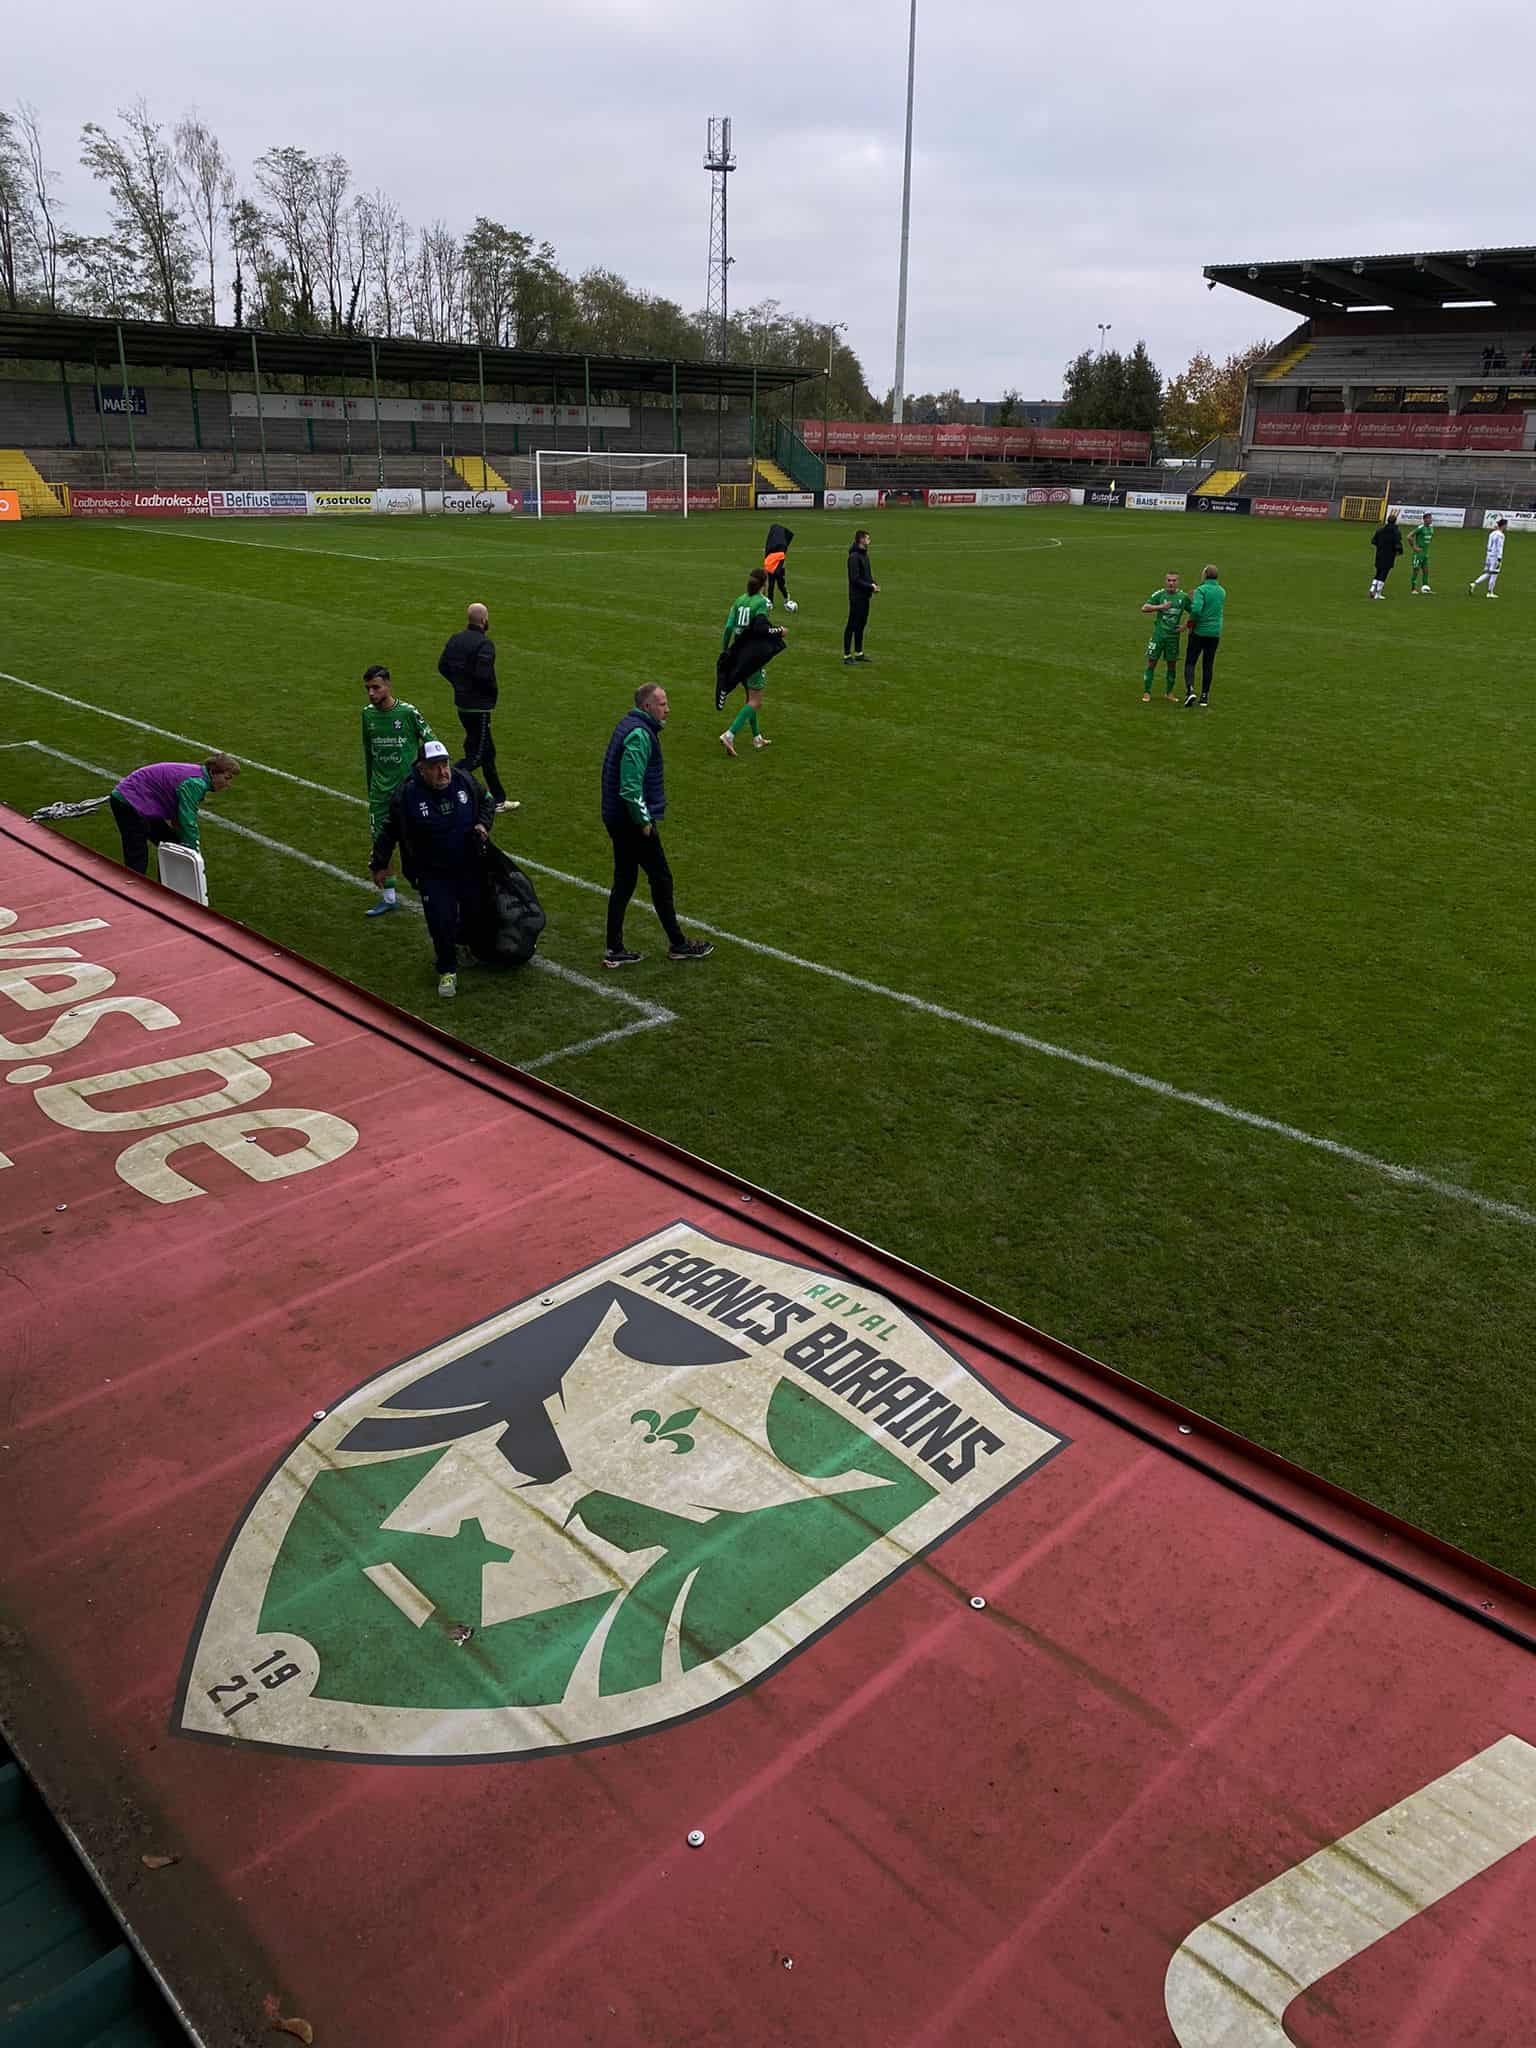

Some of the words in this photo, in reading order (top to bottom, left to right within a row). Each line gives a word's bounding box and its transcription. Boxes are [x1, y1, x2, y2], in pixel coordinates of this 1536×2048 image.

[103, 398, 134, 412] MAES
[73, 496, 131, 508] Ladbrokes.be
[135, 494, 208, 507] Ladbrokes.be
[226, 492, 270, 507] Belfius
[443, 494, 489, 512] Cegelec
[737, 606, 750, 626] 10
[804, 1283, 900, 1342] ROYAL
[620, 1247, 817, 1347] FRANCS
[784, 1321, 1006, 1485] BORAINS
[251, 1649, 301, 1690] 19
[206, 1674, 259, 1718] 21
